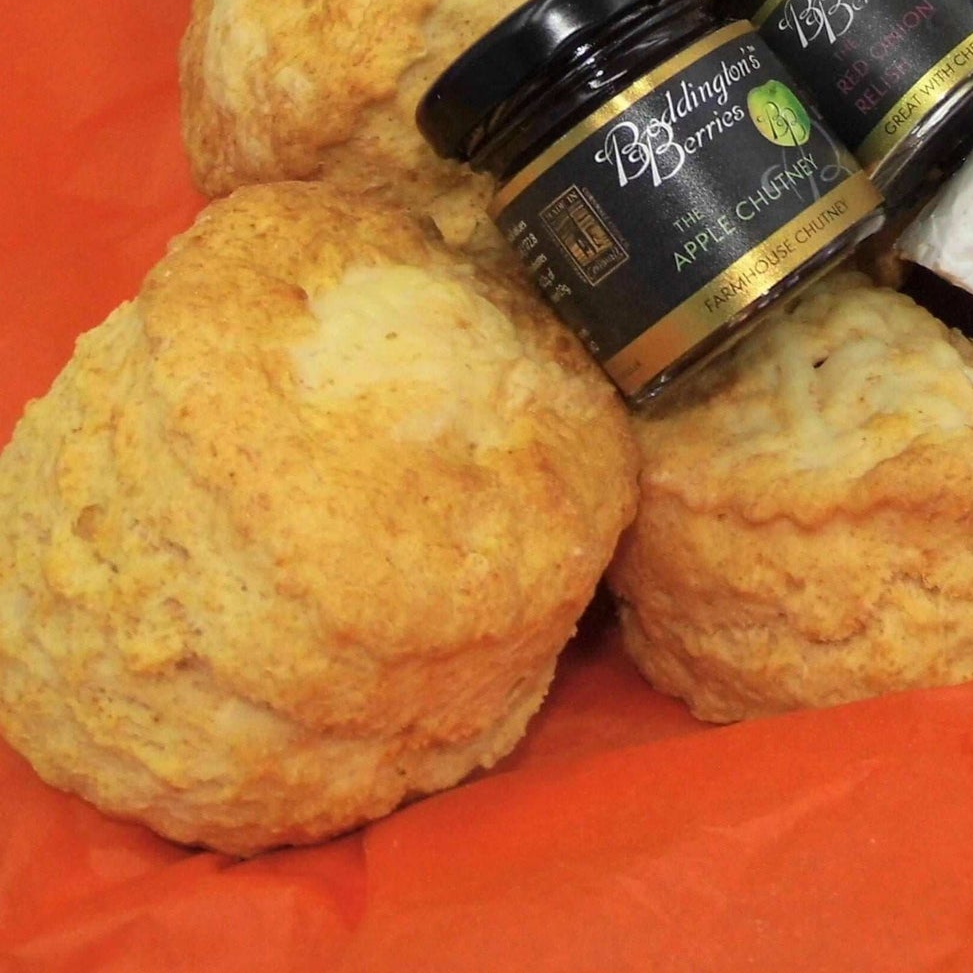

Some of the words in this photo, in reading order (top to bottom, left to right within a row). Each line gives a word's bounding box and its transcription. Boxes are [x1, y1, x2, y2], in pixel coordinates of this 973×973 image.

[836, 60, 869, 94] RED
[870, 0, 937, 60] ONION
[854, 59, 912, 115] RELISH
[594, 47, 761, 188] Boddington's
[885, 96, 922, 137] GREAT
[920, 64, 955, 96] WITH
[630, 104, 745, 187] Berries
[673, 217, 737, 272] APPLE
[735, 153, 819, 221] CHUTNEY
[673, 208, 705, 233] THE
[704, 239, 795, 314] FARMHOUSE
[795, 199, 849, 245] CHUTNEY
